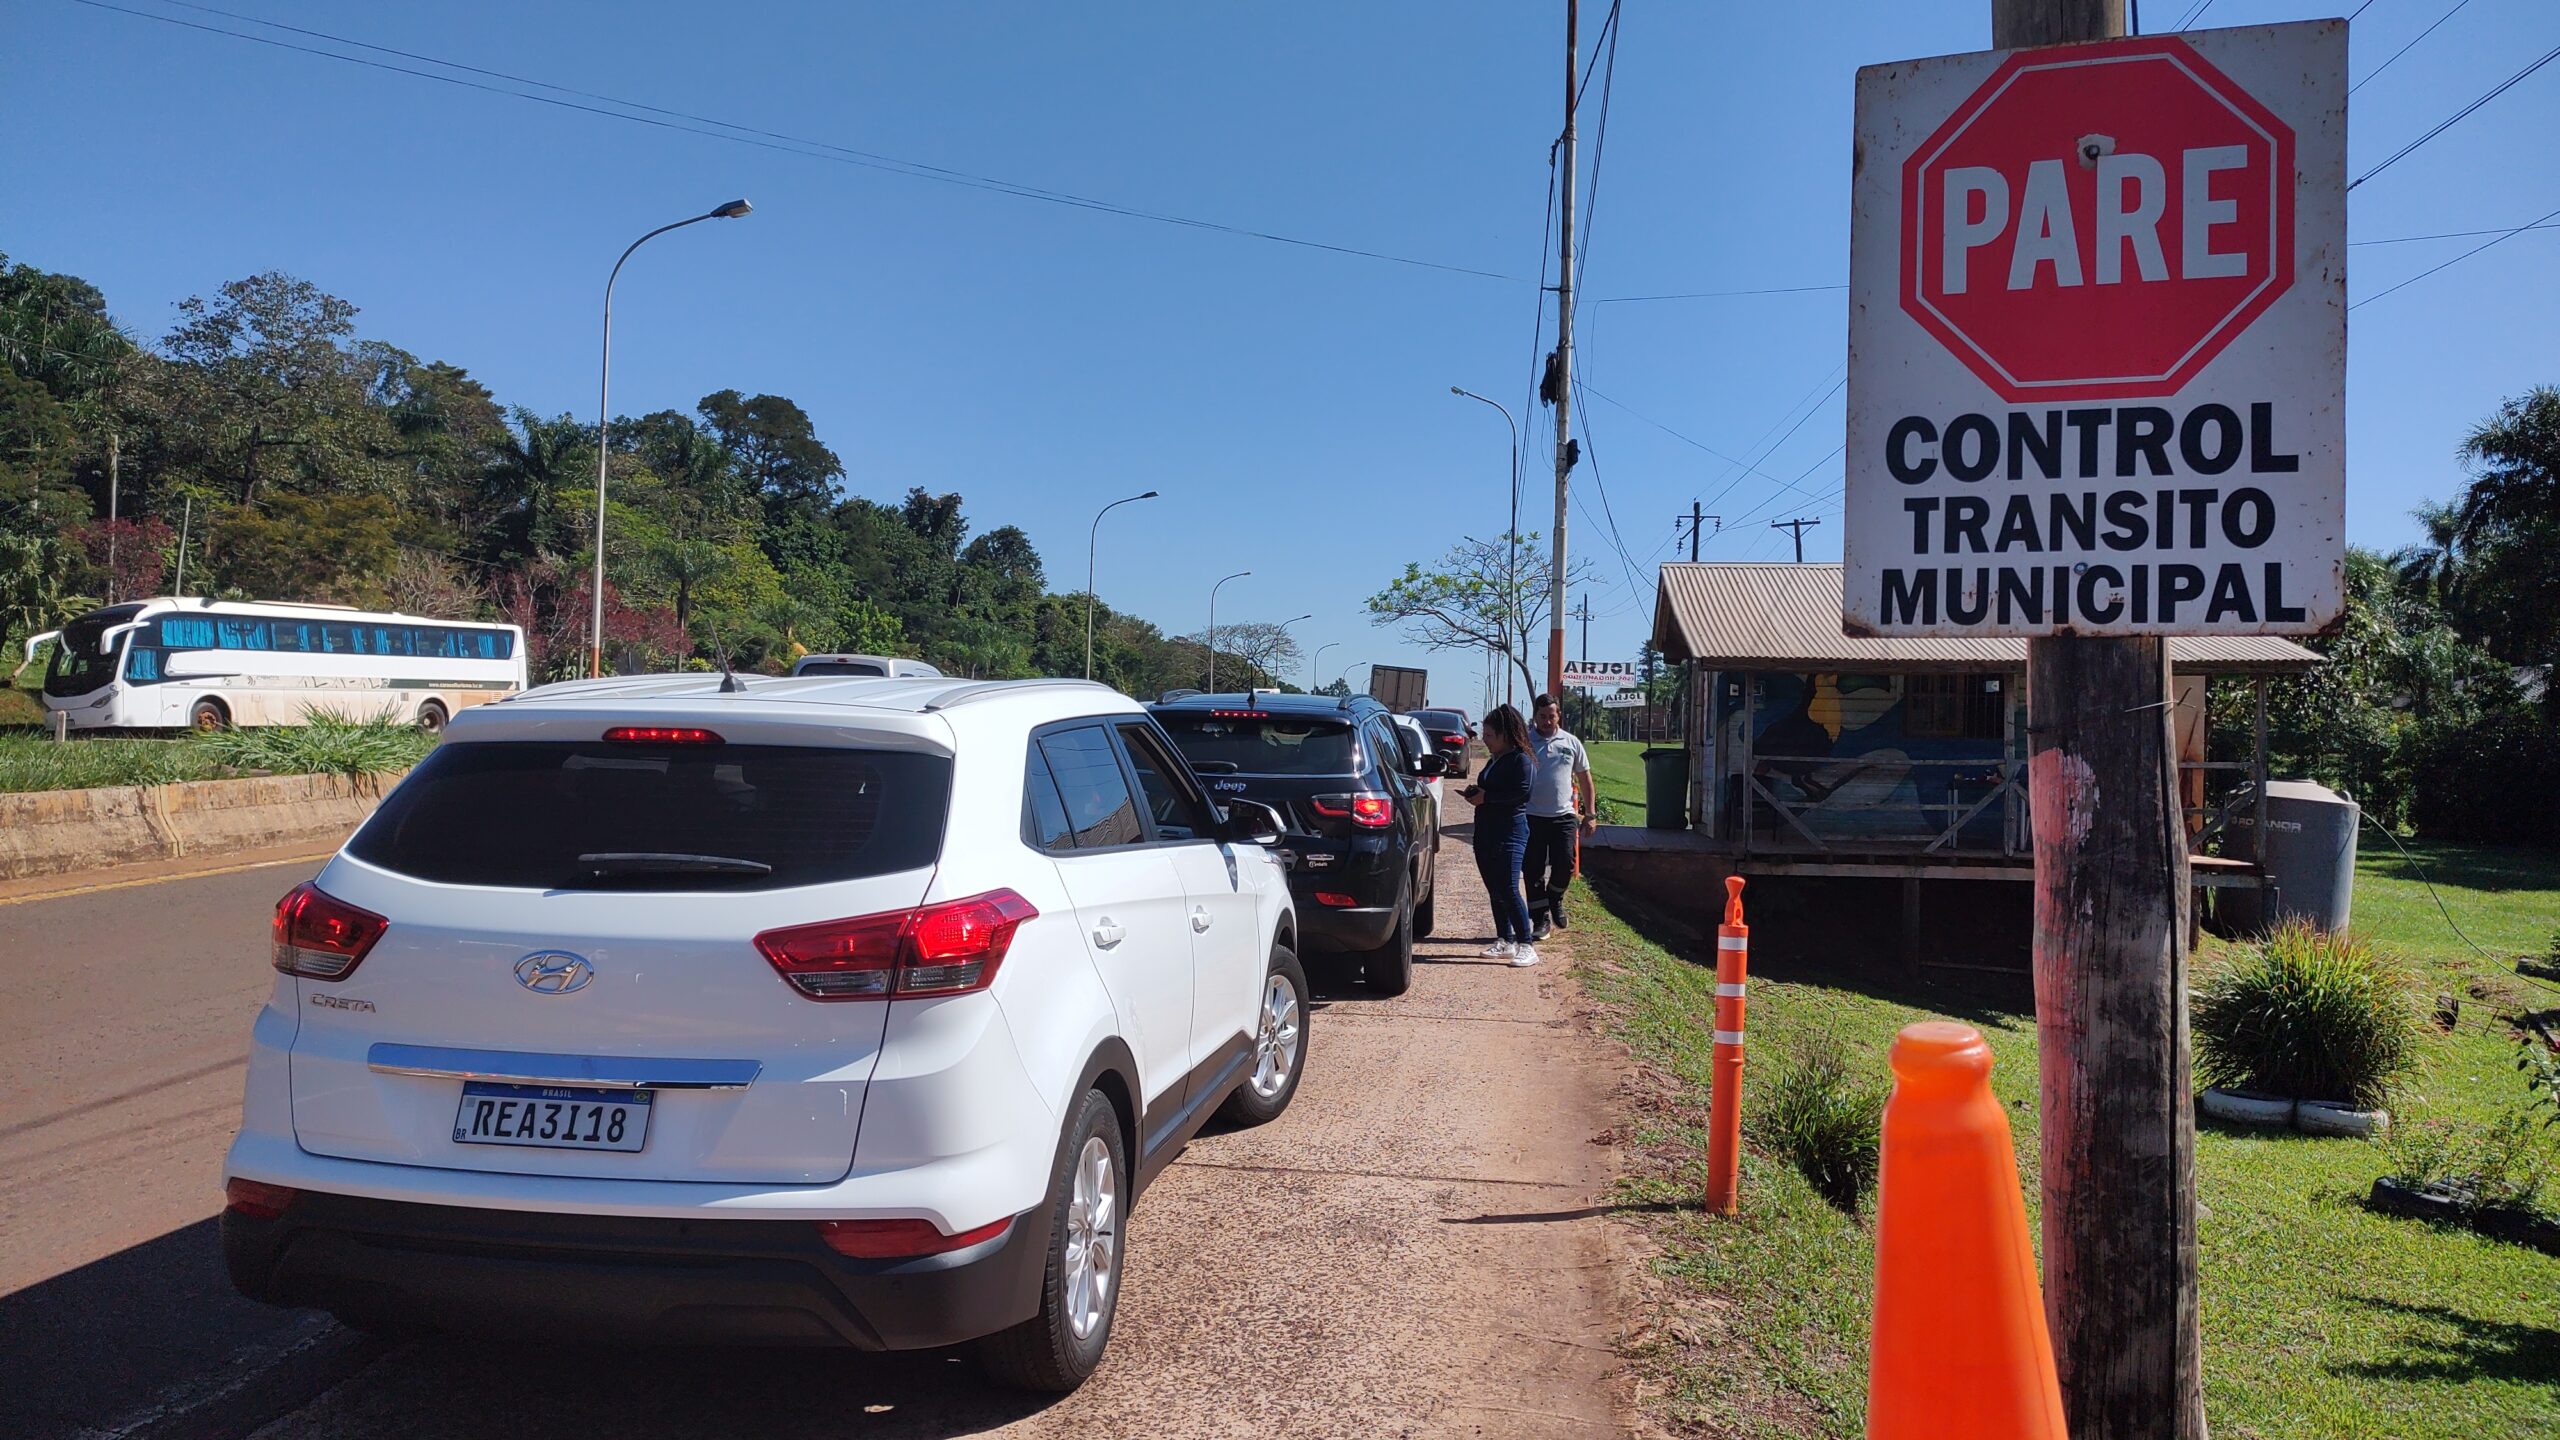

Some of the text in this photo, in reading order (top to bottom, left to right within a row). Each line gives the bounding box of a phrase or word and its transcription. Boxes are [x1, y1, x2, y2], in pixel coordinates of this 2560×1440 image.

[1942, 144, 2248, 295] PARE
[1885, 402, 2299, 485] CONTROL
[1903, 487, 2276, 555] TRANSITO
[1880, 561, 2306, 626] MUNICIPAL
[1564, 661, 1634, 675] ARJOL
[1605, 692, 1642, 701] ARJOL
[1214, 780, 1247, 792] Jeep
[309, 993, 377, 1013] CRETA
[542, 1088, 572, 1098] BRASIL
[472, 1100, 626, 1143] REA3I18
[455, 1128, 467, 1140] BR
